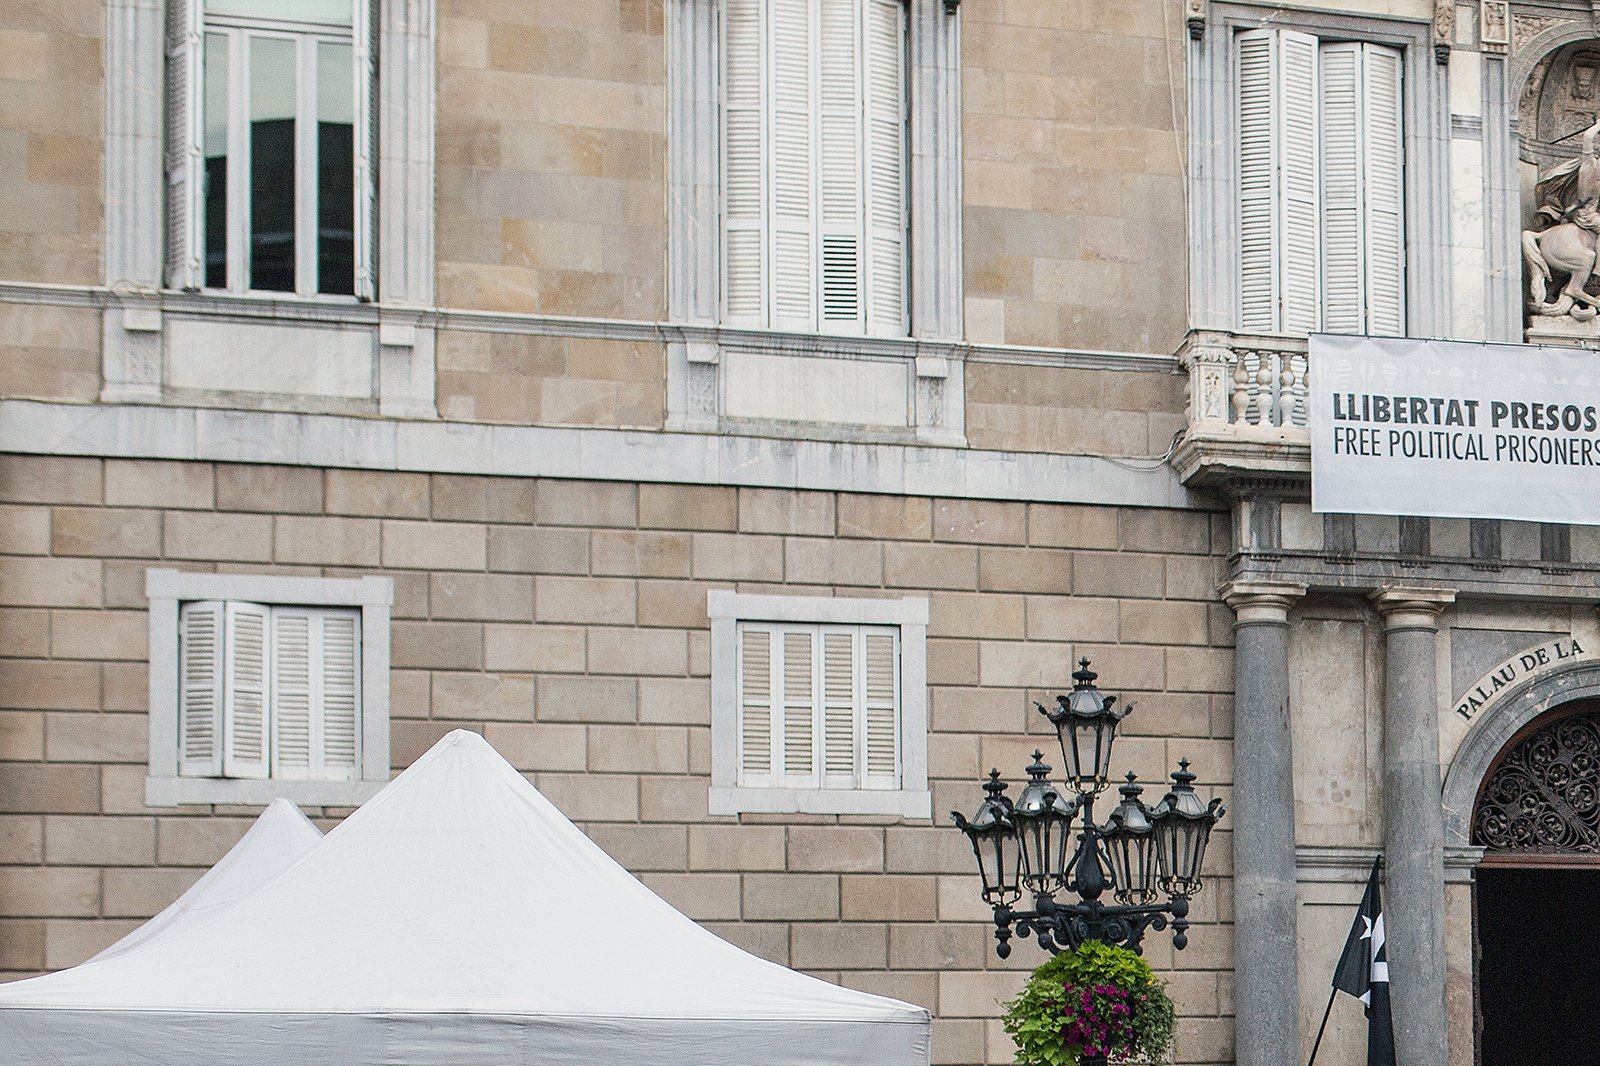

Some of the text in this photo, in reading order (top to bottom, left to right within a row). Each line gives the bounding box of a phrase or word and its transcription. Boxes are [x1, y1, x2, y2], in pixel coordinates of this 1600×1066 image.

[1332, 392, 1480, 428] LLIBERTAT
[1491, 400, 1597, 432] PRESOS
[1333, 426, 1381, 457] FREE
[1388, 429, 1490, 461] POLITICAL
[1456, 664, 1517, 721] PALAU
[1523, 647, 1551, 673] DE
[1557, 638, 1585, 659] LA
